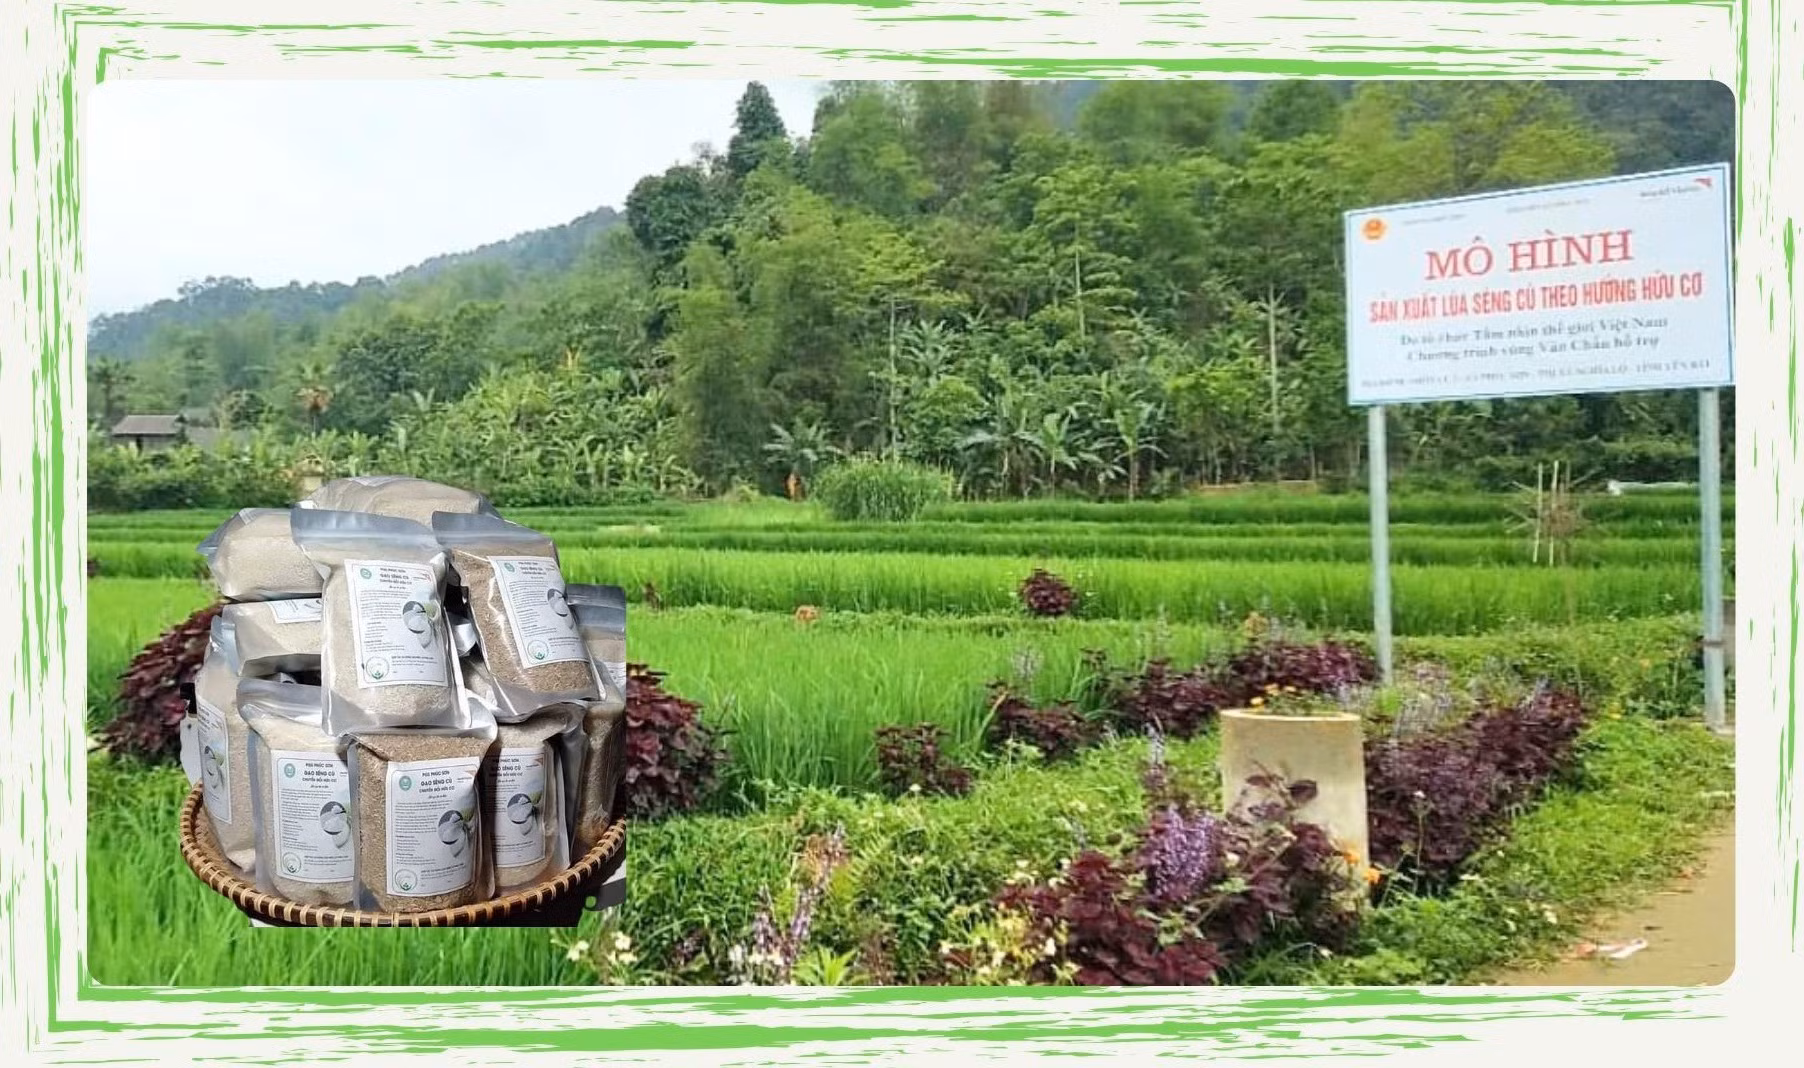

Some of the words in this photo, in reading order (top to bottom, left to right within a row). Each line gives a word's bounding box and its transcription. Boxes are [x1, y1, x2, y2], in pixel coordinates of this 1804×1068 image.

[1425, 236, 1494, 280] MÔ
[1507, 229, 1634, 272] HÌNH
[1541, 285, 1578, 309] THEO
[1632, 317, 1668, 329] Nam
